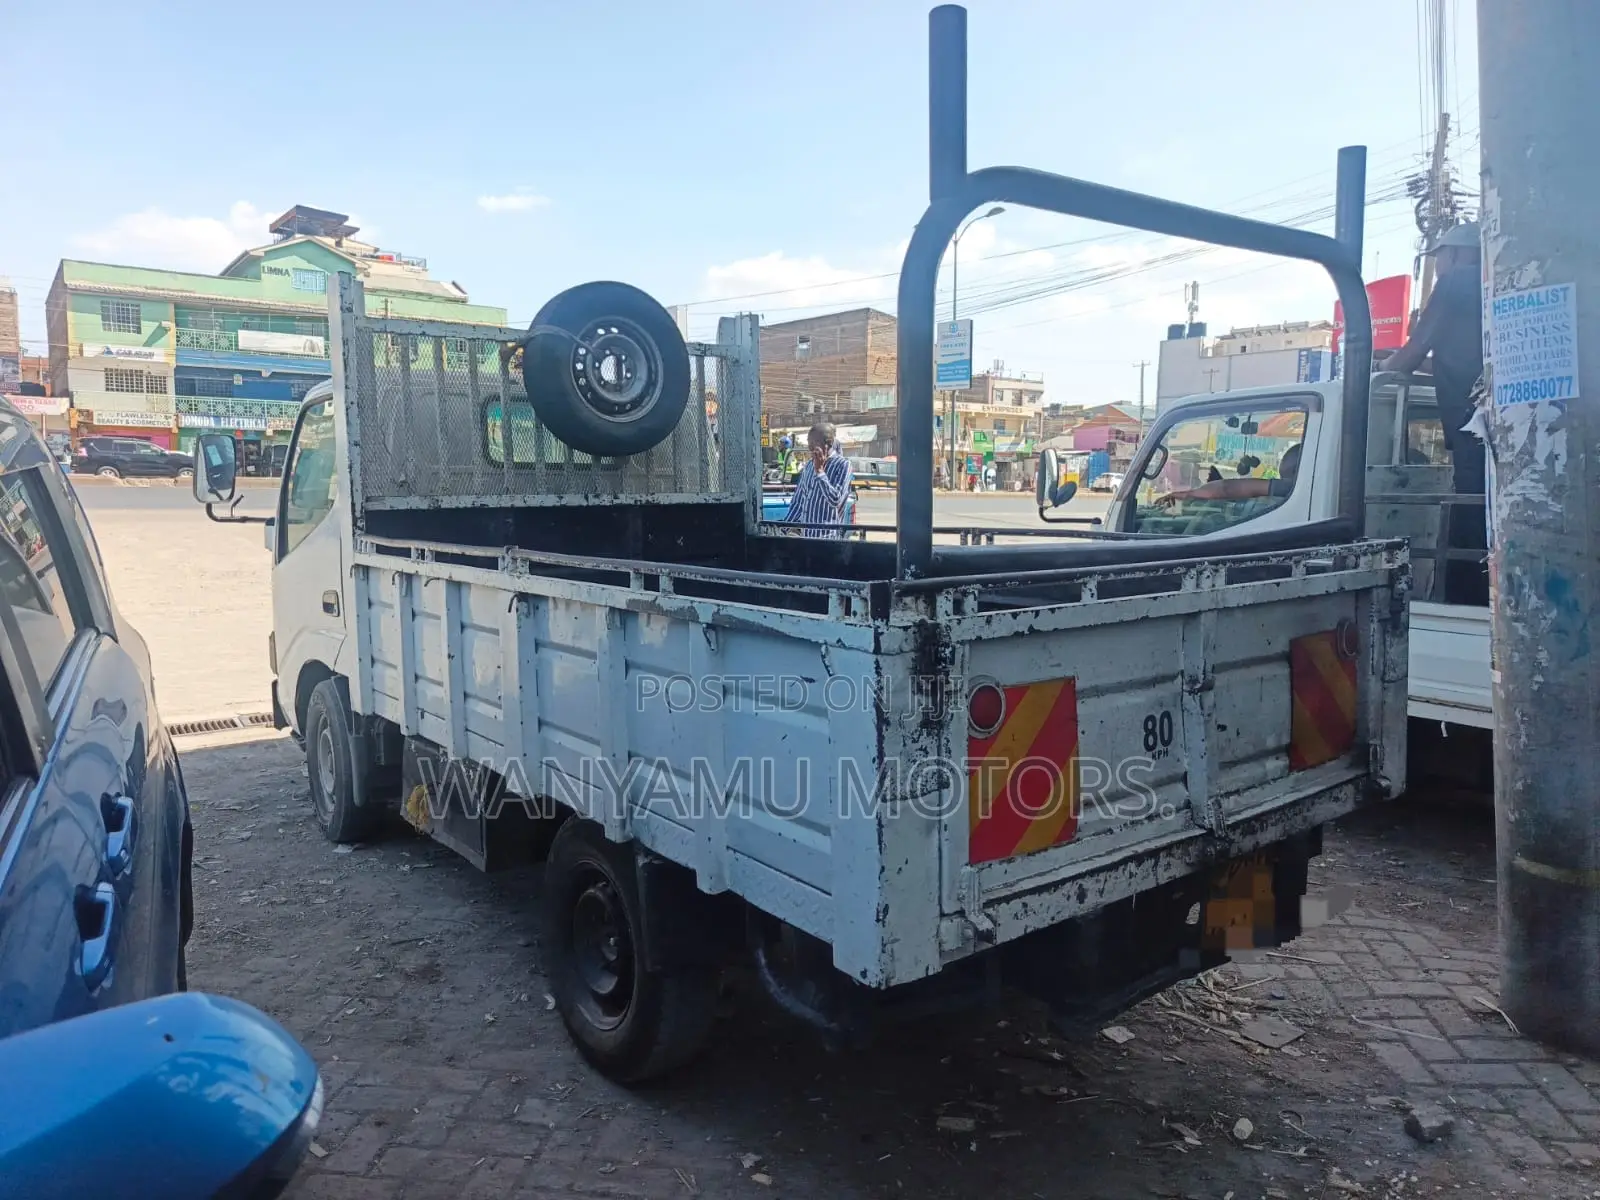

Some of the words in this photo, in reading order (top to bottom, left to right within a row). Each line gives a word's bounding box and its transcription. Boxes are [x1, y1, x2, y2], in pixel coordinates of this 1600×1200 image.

[262, 265, 290, 277] LIMNA
[1493, 286, 1570, 316] HERBALIST
[1498, 319, 1520, 332] LOVE
[1499, 321, 1570, 343] BUSINESS
[1499, 341, 1524, 356] LOST
[1530, 335, 1572, 350] ITEMS
[1499, 353, 1528, 367] FAMILY
[1531, 347, 1572, 361] AFFAIRS
[1496, 375, 1574, 405] 0728860077
[97, 418, 124, 426] BEAUTY
[130, 419, 170, 427] COSMETICS
[116, 412, 153, 420] FLAWLESS
[220, 415, 267, 429] ELECTRICAL
[1143, 710, 1173, 752] 80
[1151, 747, 1169, 761] KPH
